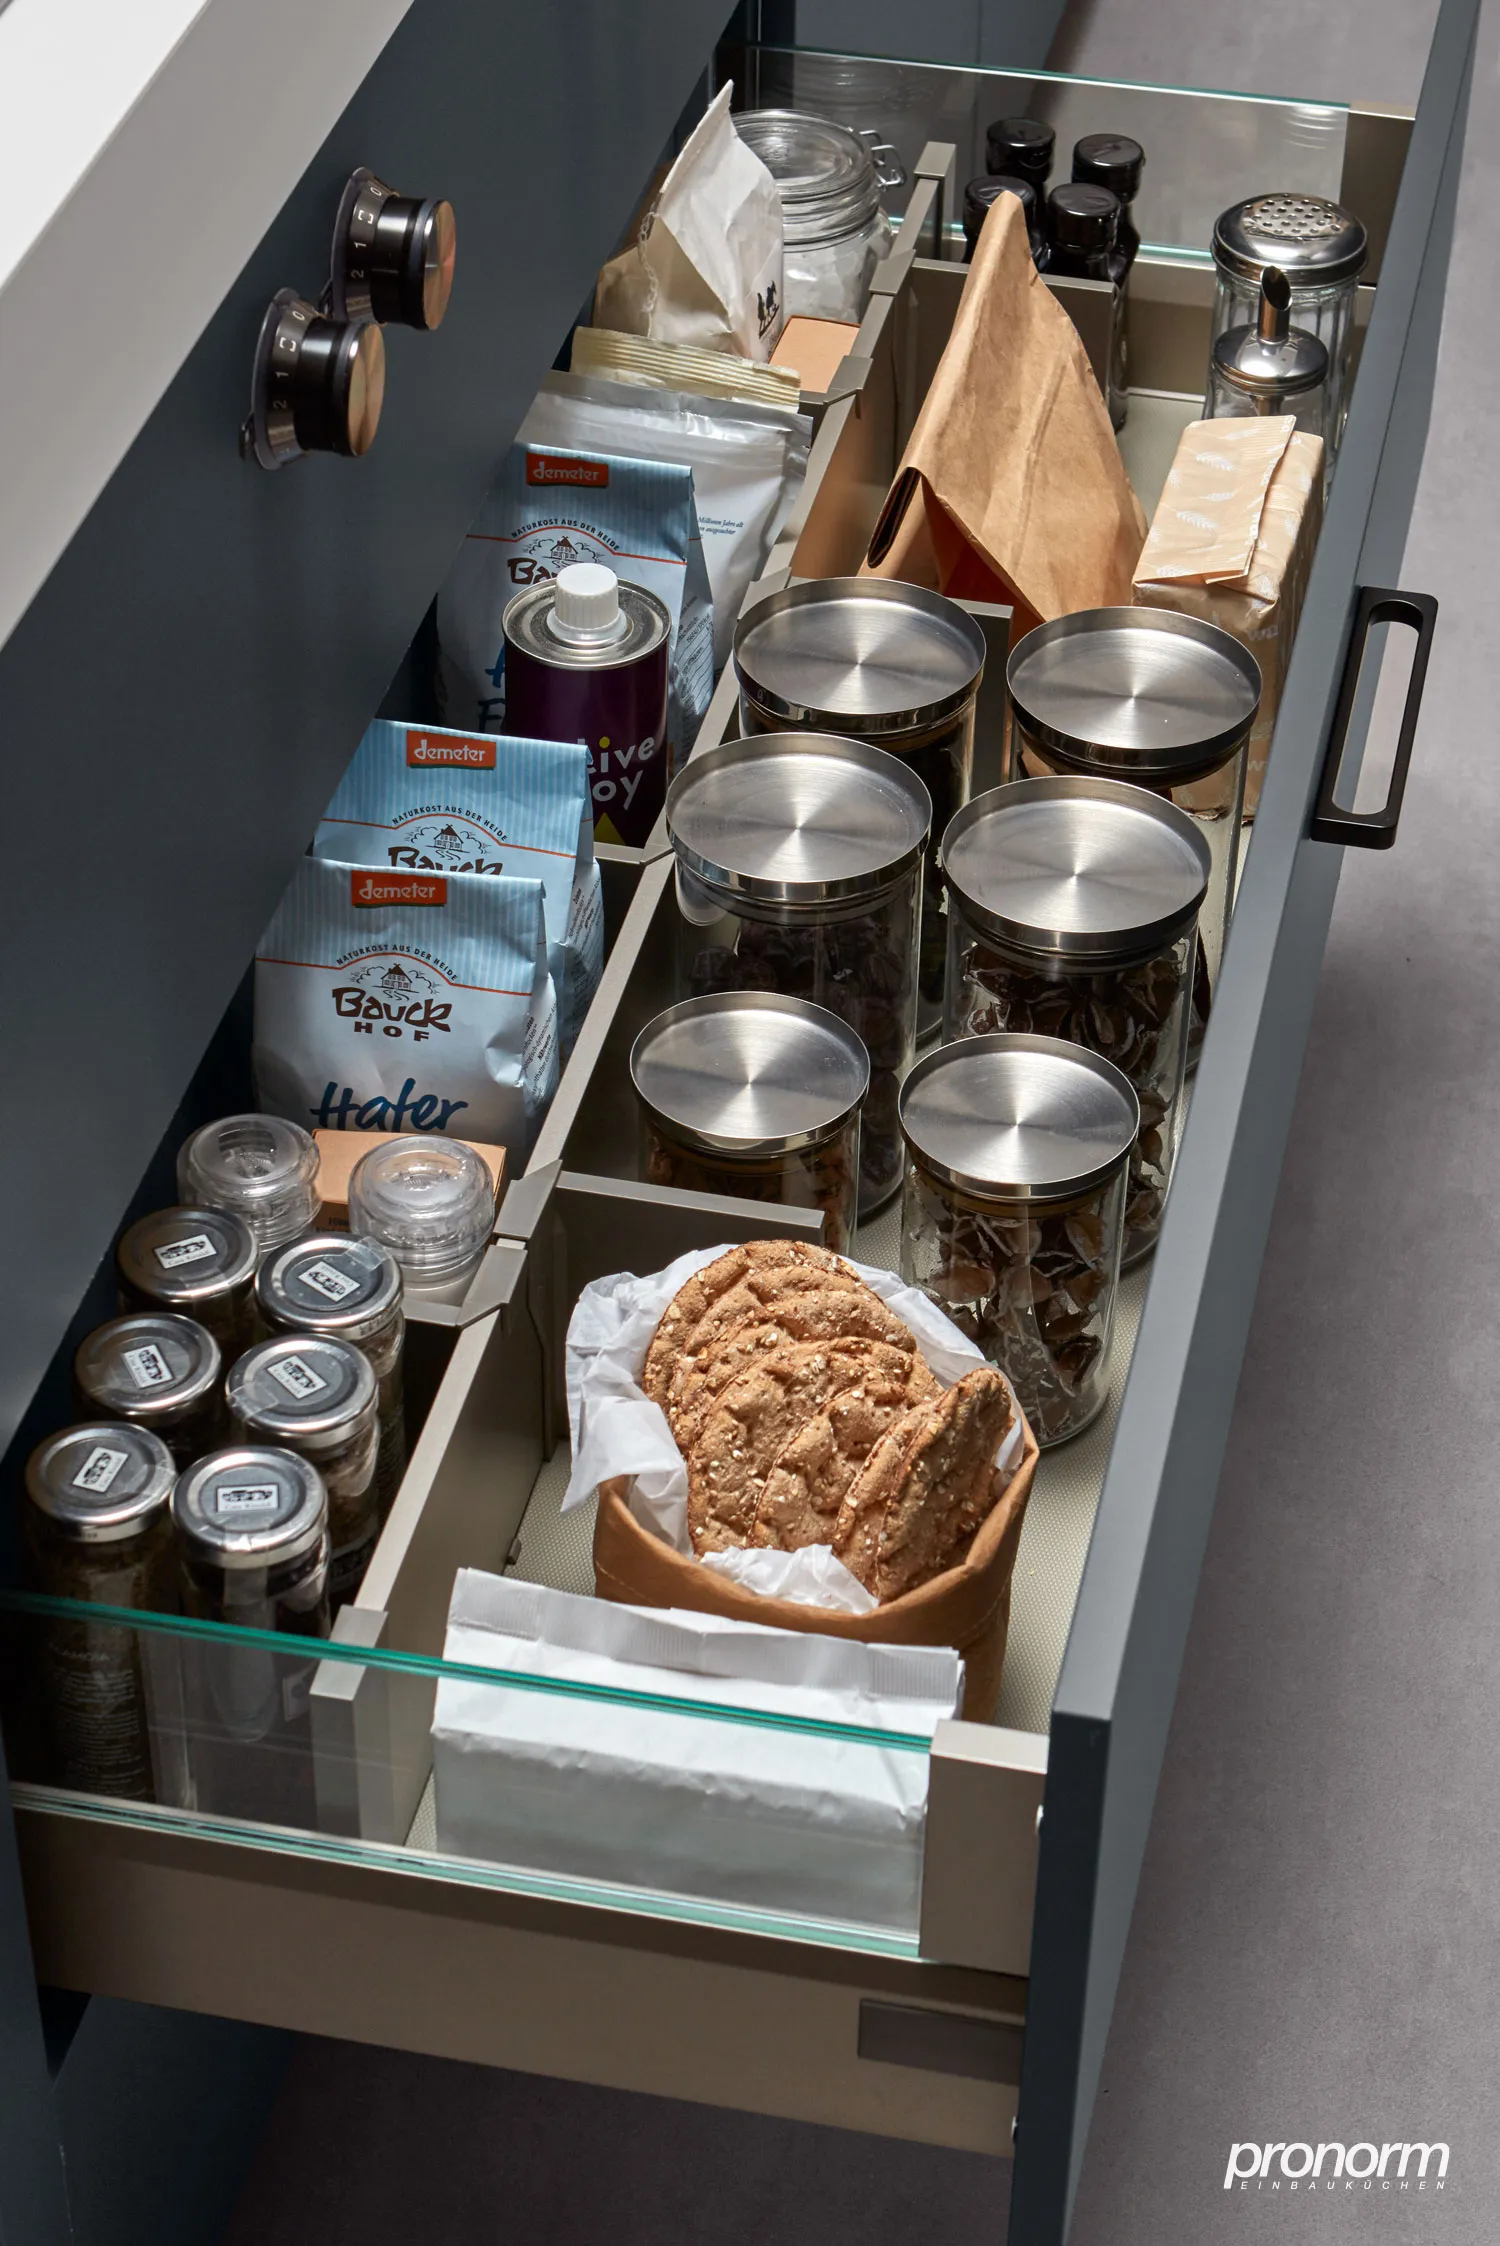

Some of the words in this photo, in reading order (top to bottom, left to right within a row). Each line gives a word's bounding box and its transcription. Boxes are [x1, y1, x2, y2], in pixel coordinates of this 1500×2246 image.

[532, 461, 600, 482] demeter
[511, 518, 558, 538] NATURKOST
[561, 519, 578, 527] AUS
[580, 521, 597, 534] DER
[597, 530, 620, 551] HEIDE
[413, 738, 487, 762] demeter
[577, 736, 656, 774] ive
[391, 805, 441, 825] NATURKOST
[445, 805, 462, 814] AUS
[465, 810, 483, 822] DER
[483, 820, 508, 841] HEIDE
[358, 878, 437, 900] demeter
[336, 944, 388, 965] NATURKOST
[392, 944, 410, 953] AUS
[414, 948, 432, 960] DER
[433, 958, 458, 981] HEIDE
[332, 987, 453, 1032] Bauck
[353, 1021, 430, 1042] HOF
[309, 1077, 469, 1132] Hafer
